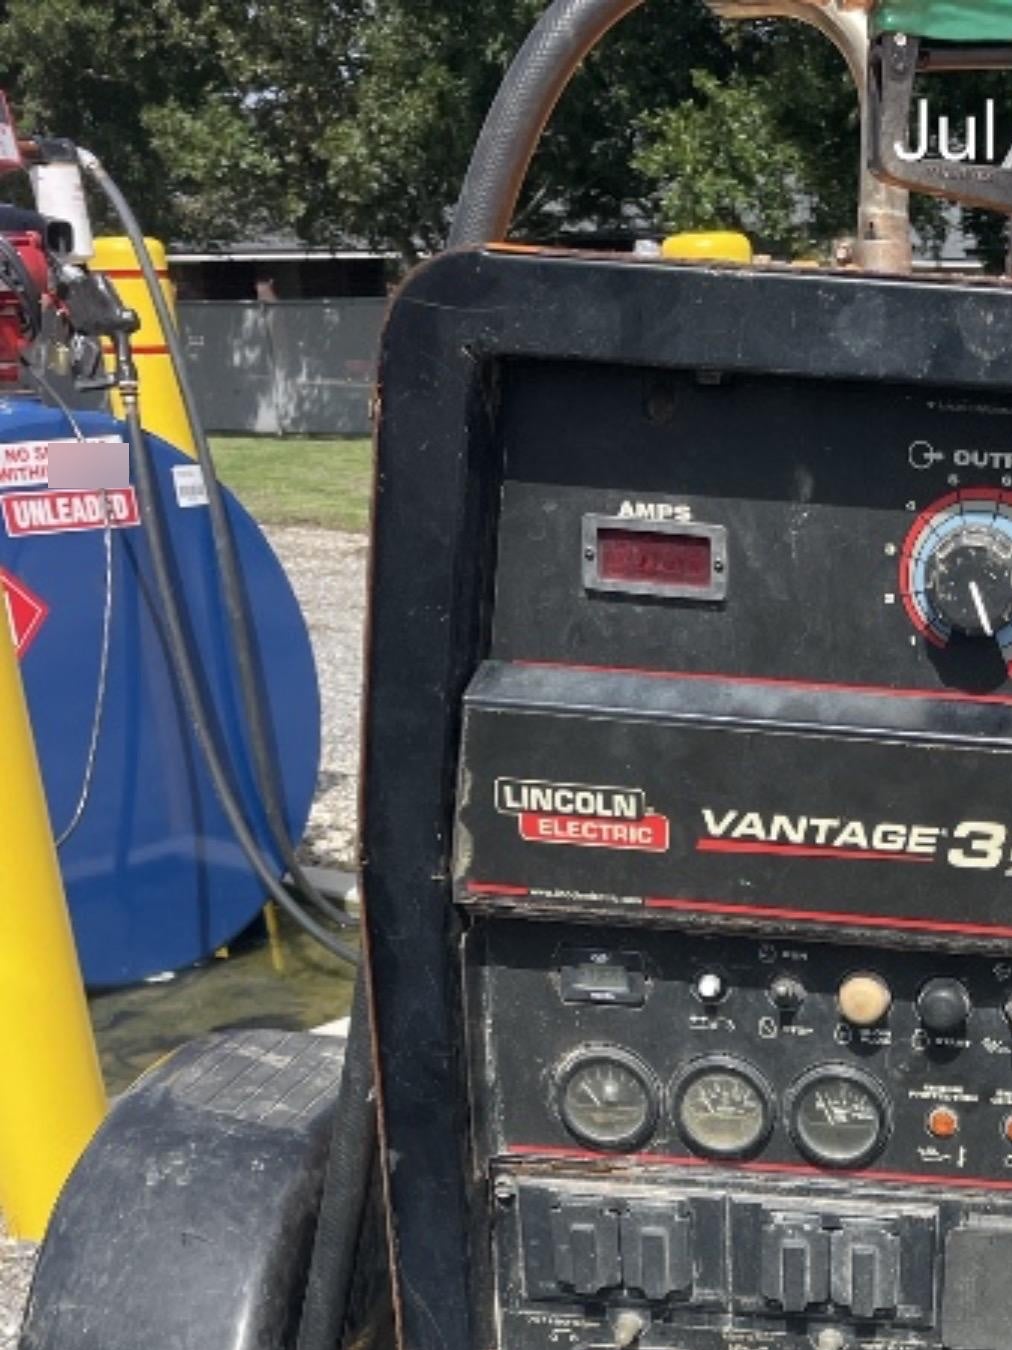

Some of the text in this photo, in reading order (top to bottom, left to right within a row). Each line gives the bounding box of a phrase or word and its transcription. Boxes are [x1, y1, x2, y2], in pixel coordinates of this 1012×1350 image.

[615, 500, 693, 523] AMPS
[502, 784, 639, 819] LINCOLN
[536, 818, 655, 845] ELECTRIC
[700, 808, 940, 854] VANTAGE
